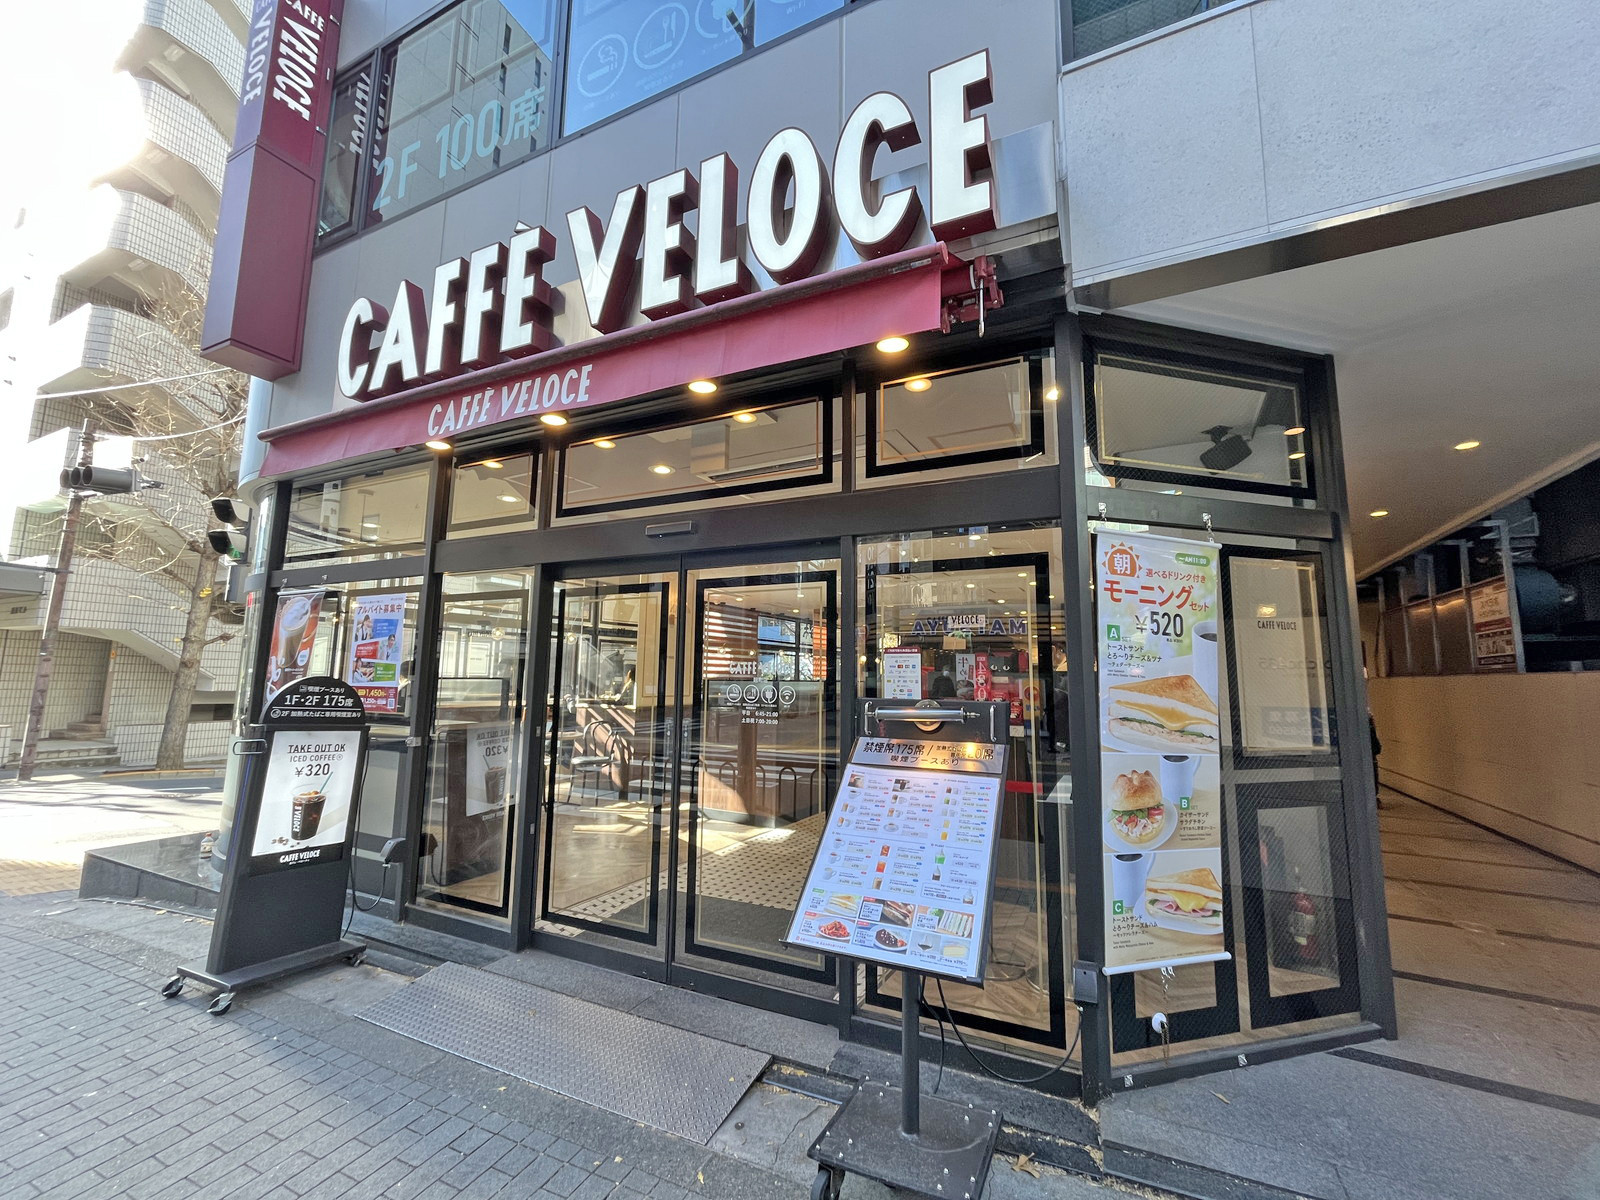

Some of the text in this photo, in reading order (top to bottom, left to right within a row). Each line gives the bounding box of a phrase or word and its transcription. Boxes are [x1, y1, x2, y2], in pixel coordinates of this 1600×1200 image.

[243, 6, 273, 106] VELOCE
[273, 16, 320, 121] VELOCE
[372, 141, 421, 211] 2F
[436, 85, 545, 179] 100席
[337, 48, 994, 400] CAFFÈ VELOCE
[427, 364, 593, 437] CAFFÈ VELOCE
[1113, 553, 1131, 575] 朝
[1145, 568, 1207, 584] 選べるドリンク付き
[1103, 579, 1210, 612] モーニング セット
[357, 604, 402, 615] アルバイト募集中
[951, 615, 979, 625] VELOCE
[1135, 611, 1184, 638] ¥520
[1275, 621, 1297, 631] VELOCE
[1107, 643, 1145, 652] トーストサンド
[307, 685, 345, 693] 喫煙ブースあり
[323, 694, 354, 707] 175席
[288, 743, 346, 753] TAKE OUT OK
[289, 755, 308, 763] ICED
[890, 755, 960, 766] 喫煙ブースあり
[294, 763, 331, 777] ¥320
[299, 849, 321, 860] VELOCE
[1113, 914, 1143, 924] トーストサンド
